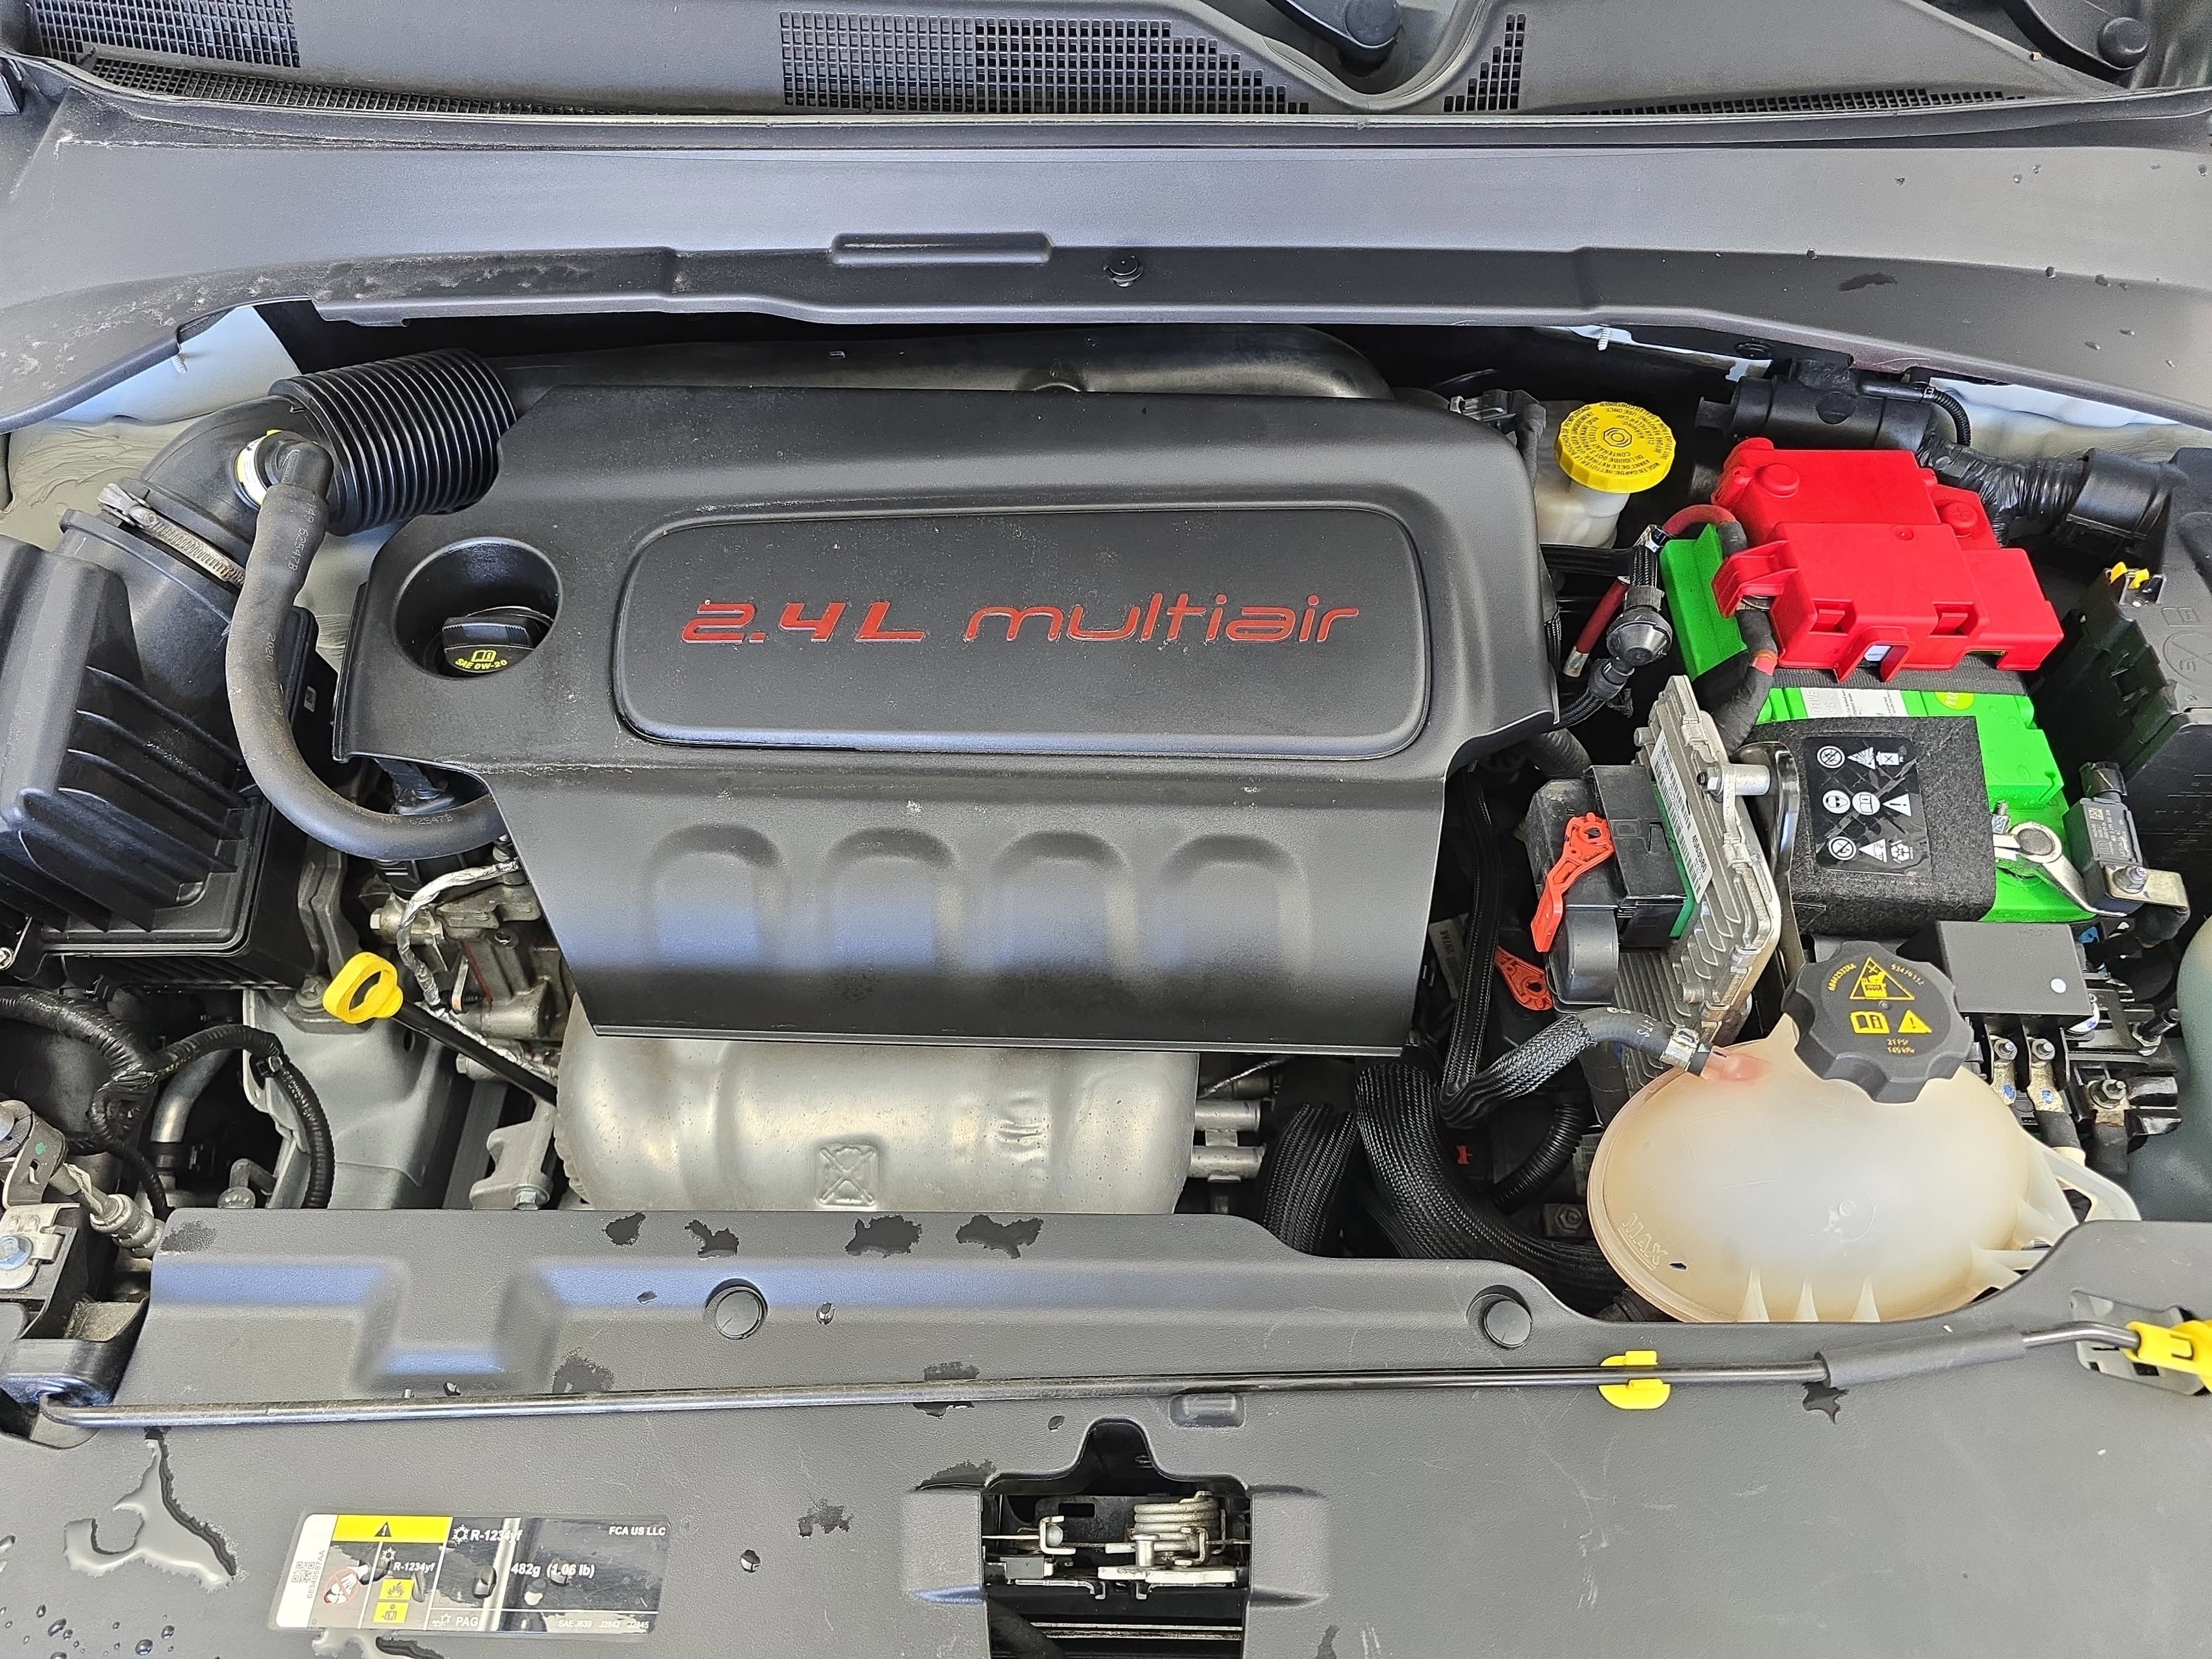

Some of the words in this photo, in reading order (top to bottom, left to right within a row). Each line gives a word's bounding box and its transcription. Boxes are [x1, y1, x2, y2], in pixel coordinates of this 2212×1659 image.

[1655, 437, 1663, 454] BEFORE
[1632, 460, 1650, 468] AVANT
[1661, 451, 1669, 460] DOT
[1648, 462, 1661, 471] MISE
[964, 591, 1360, 644] multiair
[455, 658, 474, 669] SAE
[474, 659, 508, 670] 0W-20
[1692, 835, 1707, 873] 4563580
[1621, 1212, 1669, 1266] MAX
[471, 1529, 524, 1544] R-1234yf
[608, 1526, 628, 1536] FCA
[631, 1526, 644, 1536] US
[645, 1526, 667, 1536] LLC
[307, 1550, 326, 1598] 68340587AA
[393, 1562, 436, 1574] R-1234yf
[511, 1562, 542, 1578] 482g
[546, 1562, 577, 1578] (1.06
[578, 1564, 595, 1579] lb)
[455, 1616, 479, 1627] PAG
[577, 1619, 592, 1628] J639
